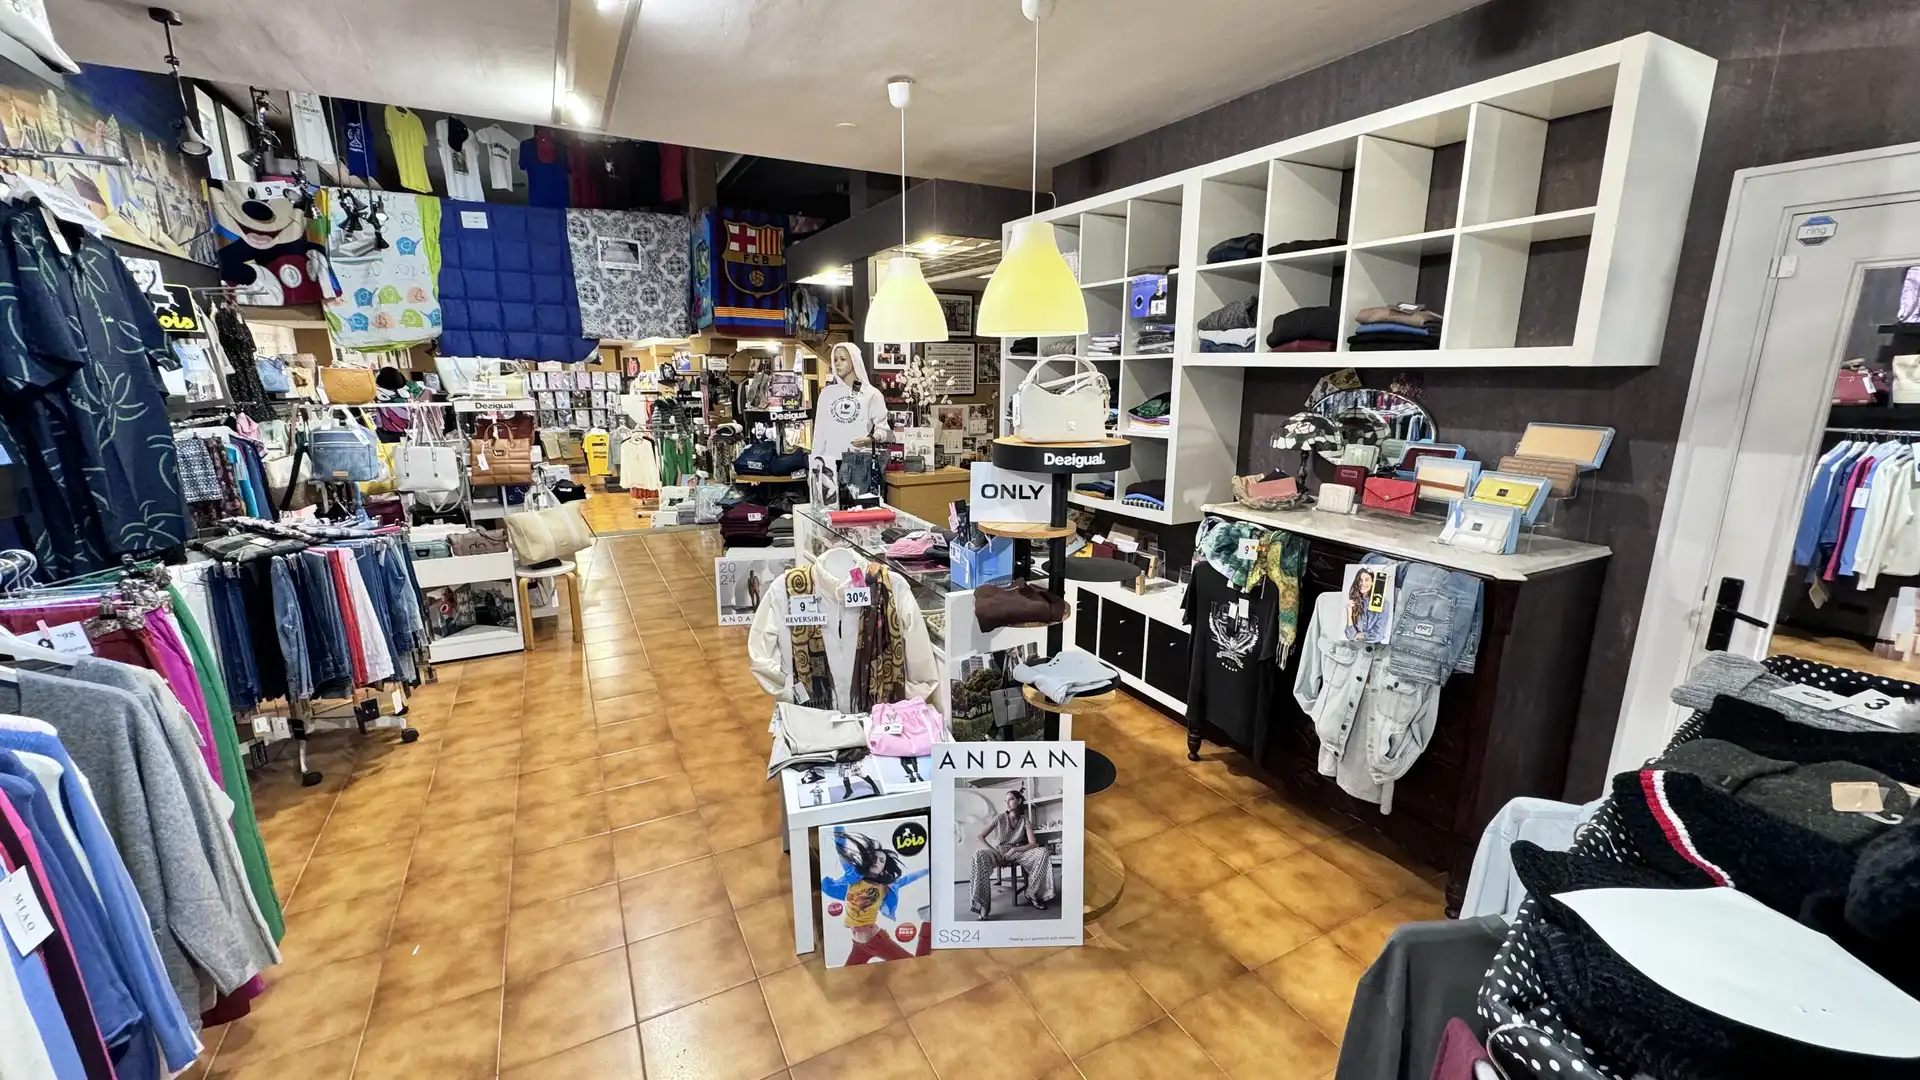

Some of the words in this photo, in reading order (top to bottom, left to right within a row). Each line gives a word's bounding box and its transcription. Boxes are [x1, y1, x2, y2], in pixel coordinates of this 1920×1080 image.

[264, 186, 273, 196] 9
[1806, 227, 1827, 236] ring
[743, 254, 770, 265] FCB
[158, 311, 195, 329] ois
[980, 483, 1045, 500] ONLY
[1244, 545, 1250, 555] 9
[719, 562, 737, 574] 20
[719, 574, 737, 585] 24
[846, 592, 869, 603] 30%
[799, 601, 806, 612] 9
[721, 615, 755, 624] ANDA
[785, 615, 826, 624] REVERSIBLE
[1864, 698, 1891, 710] 3
[938, 749, 1078, 770] ANDAM
[896, 833, 925, 850] Lois
[13, 892, 36, 932] MIAO
[938, 929, 981, 943] SS24
